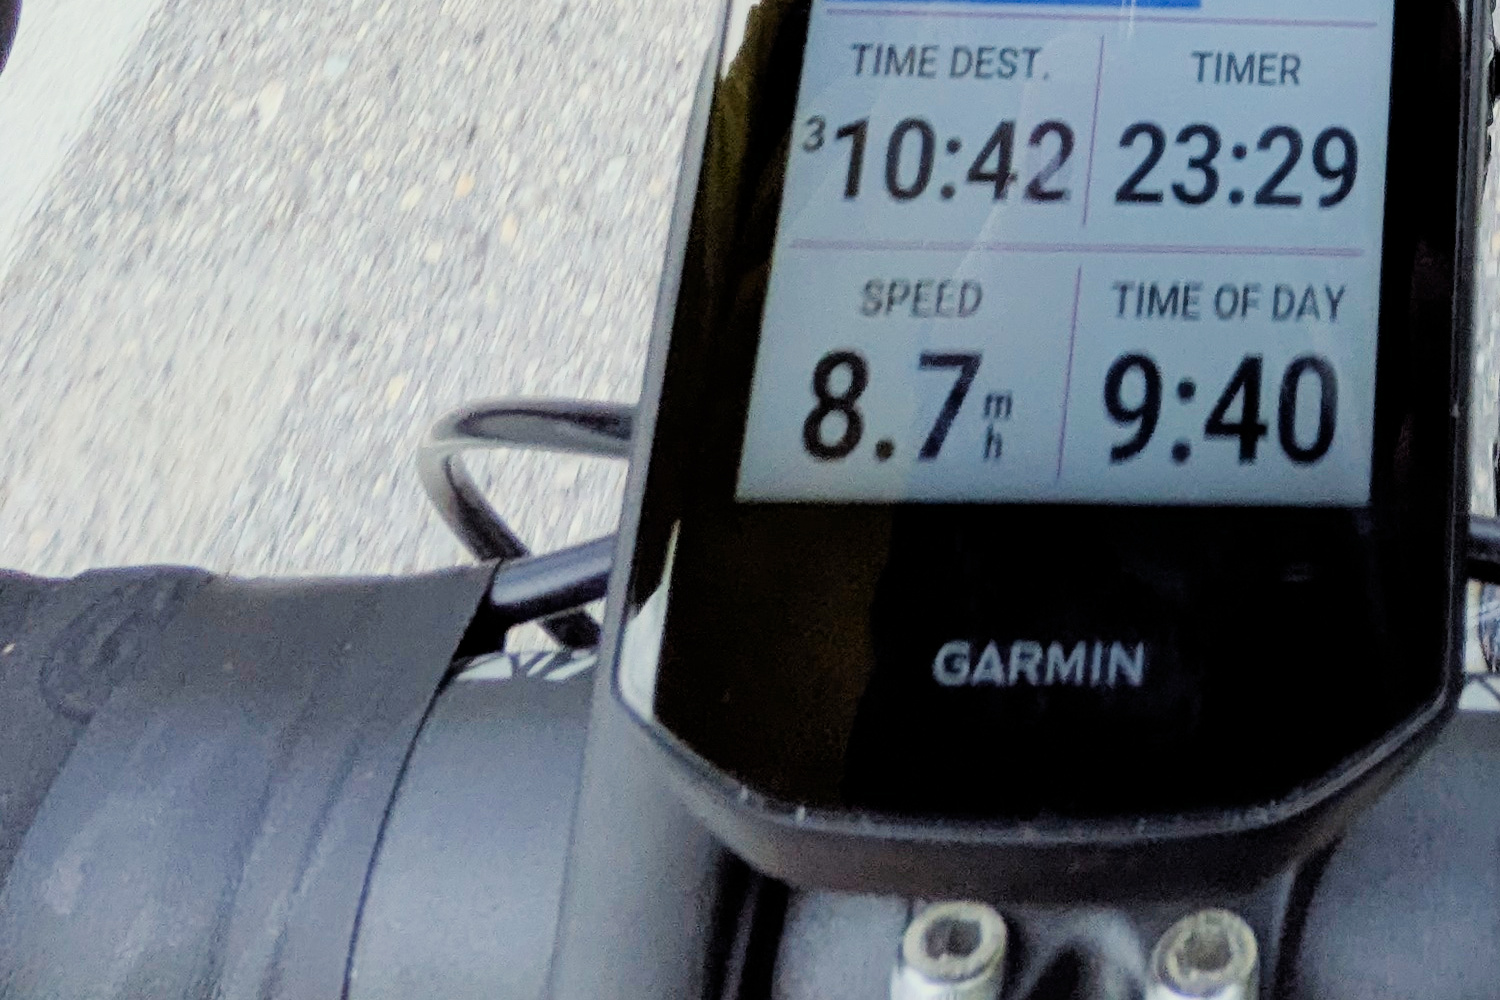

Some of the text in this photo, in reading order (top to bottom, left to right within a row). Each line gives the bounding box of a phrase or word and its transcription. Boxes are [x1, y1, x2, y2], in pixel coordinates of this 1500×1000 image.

[851, 43, 1050, 82] TIME DEST.
[1191, 51, 1301, 87] TIMER
[1114, 121, 1360, 209] 23:29
[860, 277, 984, 319] SPEED
[1110, 280, 1347, 323] TIME OF DAY
[802, 349, 985, 462] 8.7
[1102, 350, 1341, 466] 9:40
[931, 639, 1146, 688] GARMIN
